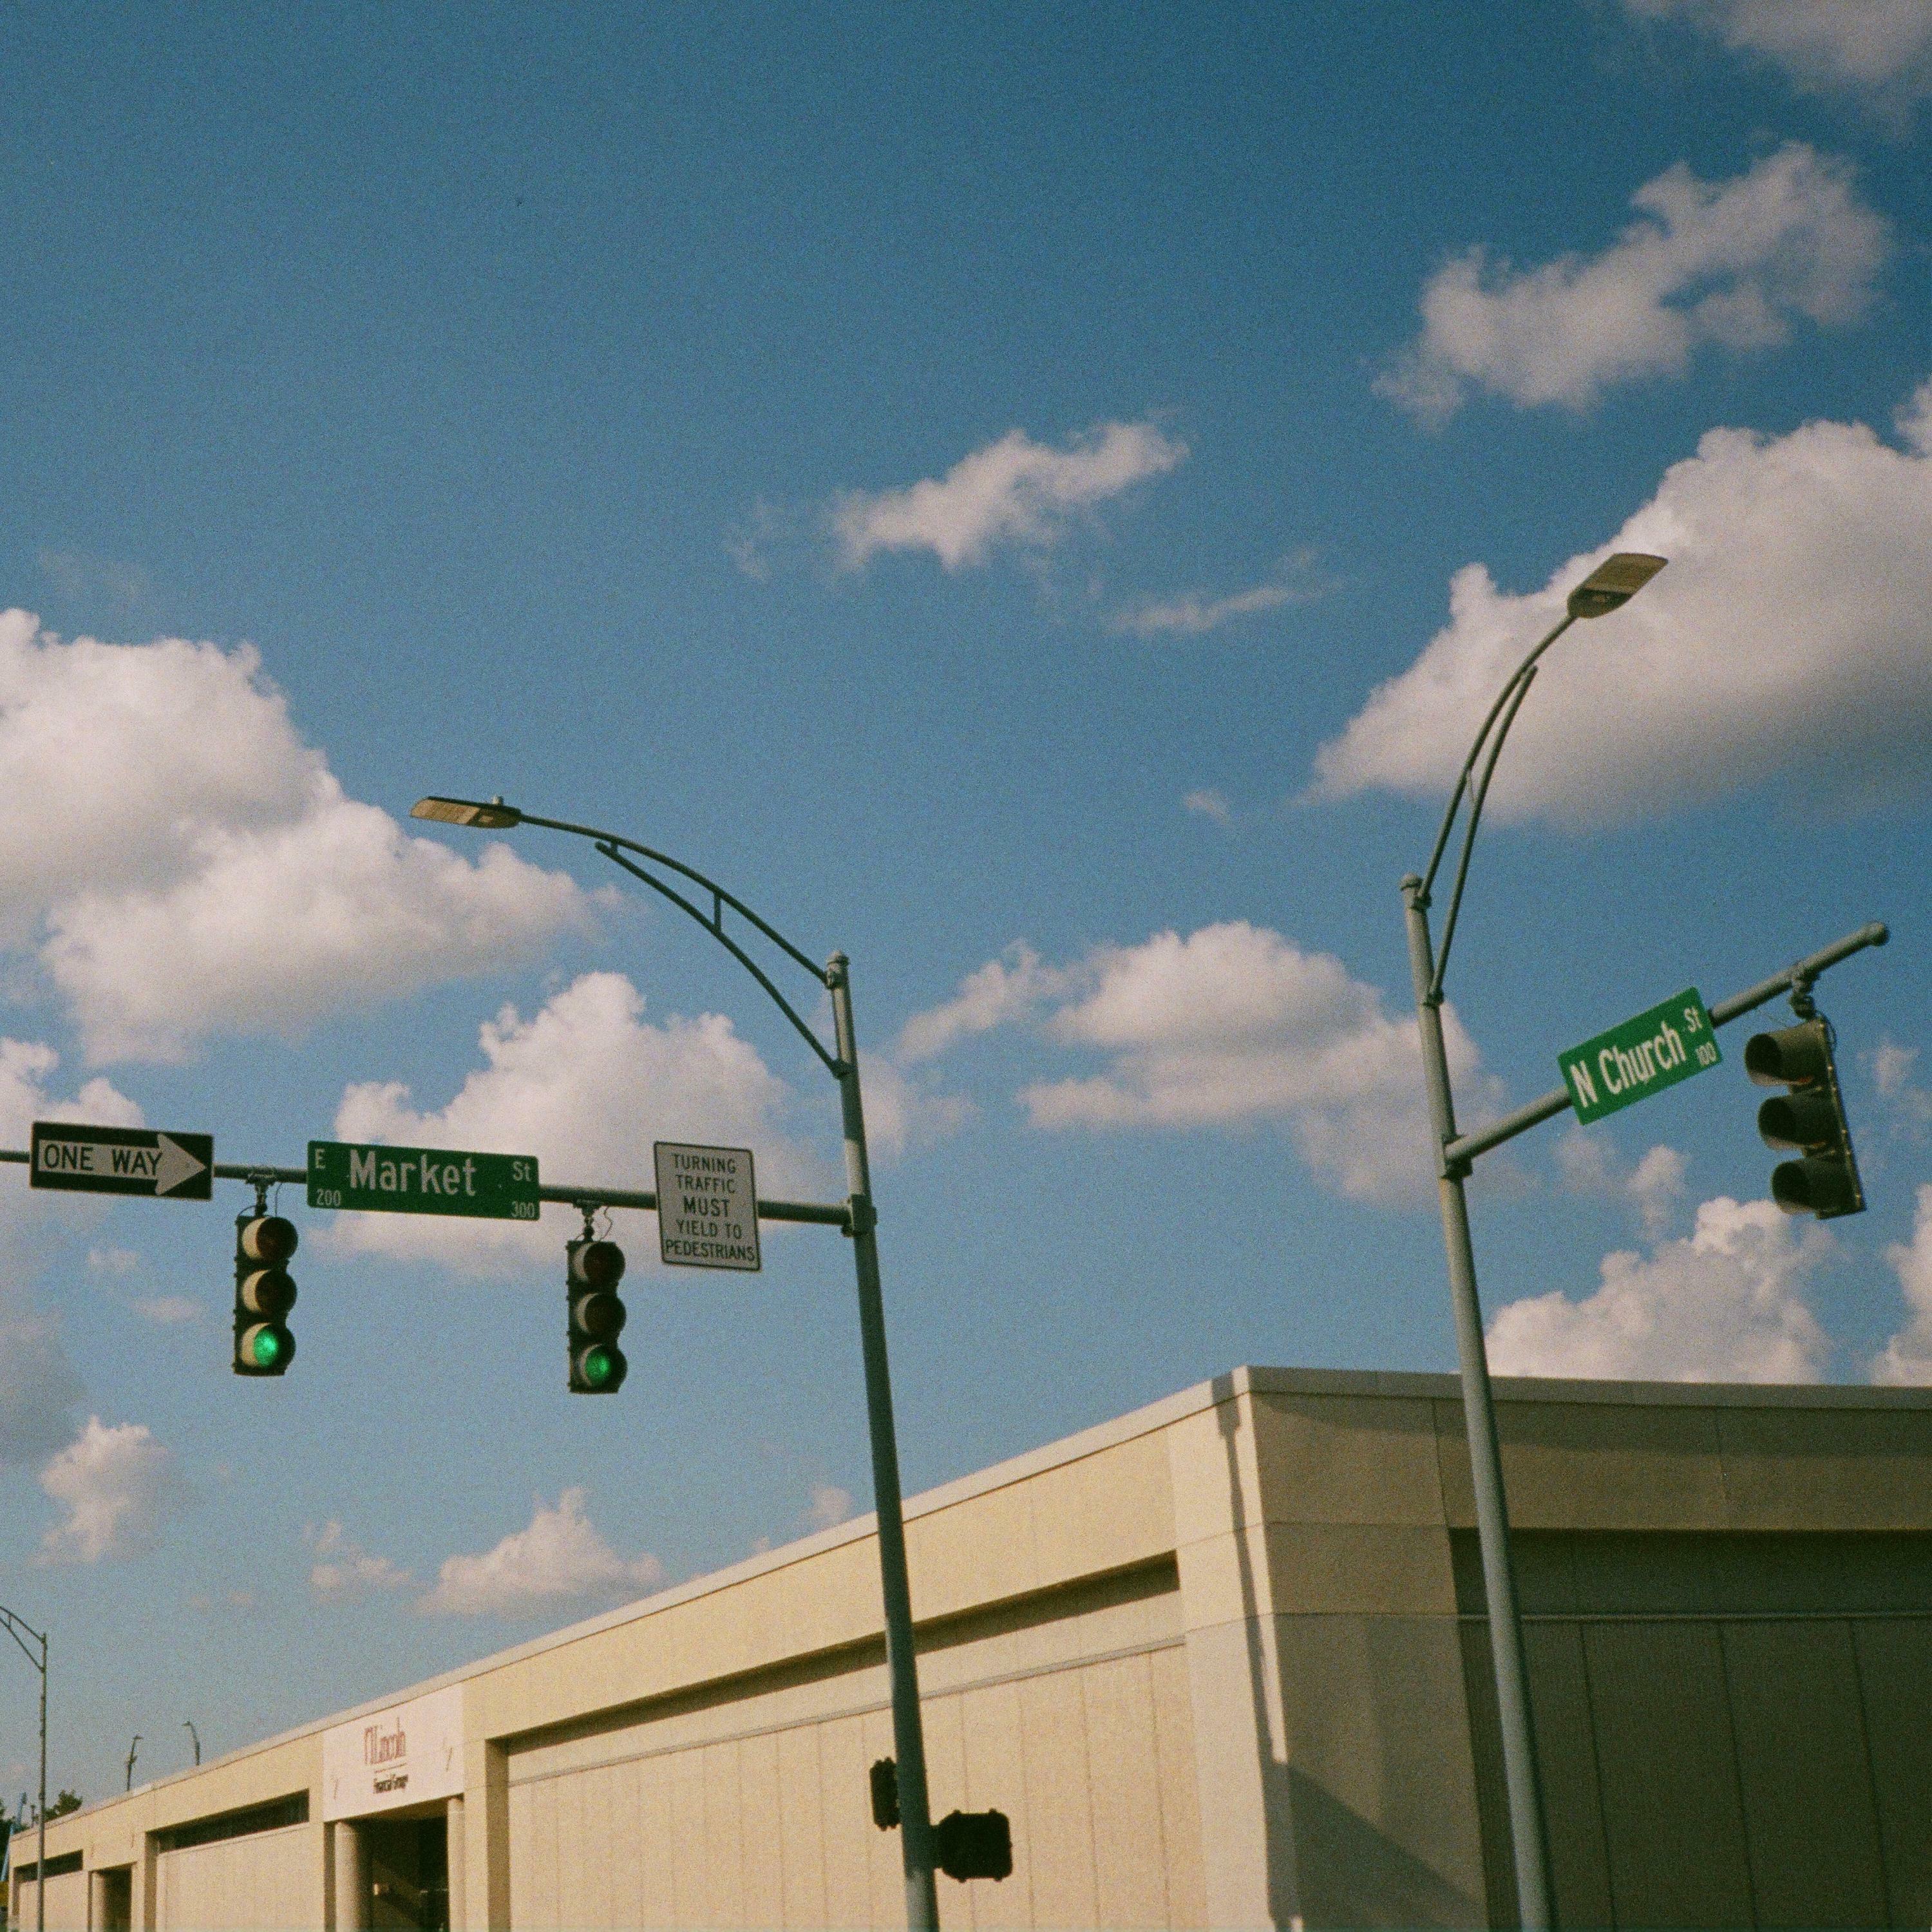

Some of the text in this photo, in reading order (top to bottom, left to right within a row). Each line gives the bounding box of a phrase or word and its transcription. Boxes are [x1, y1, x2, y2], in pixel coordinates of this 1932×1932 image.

[1569, 1006, 1703, 1108] N Church St
[44, 1143, 163, 1175] ONE WAY
[673, 1153, 737, 1174] TURNING
[314, 1148, 533, 1197] E Market St
[676, 1174, 737, 1194] TRAFFIC
[316, 1188, 341, 1206] 200
[683, 1195, 730, 1217] MUST
[511, 1200, 536, 1218] 300
[677, 1219, 743, 1240] YIELD TO
[665, 1238, 755, 1262] PEDESTRIANS
